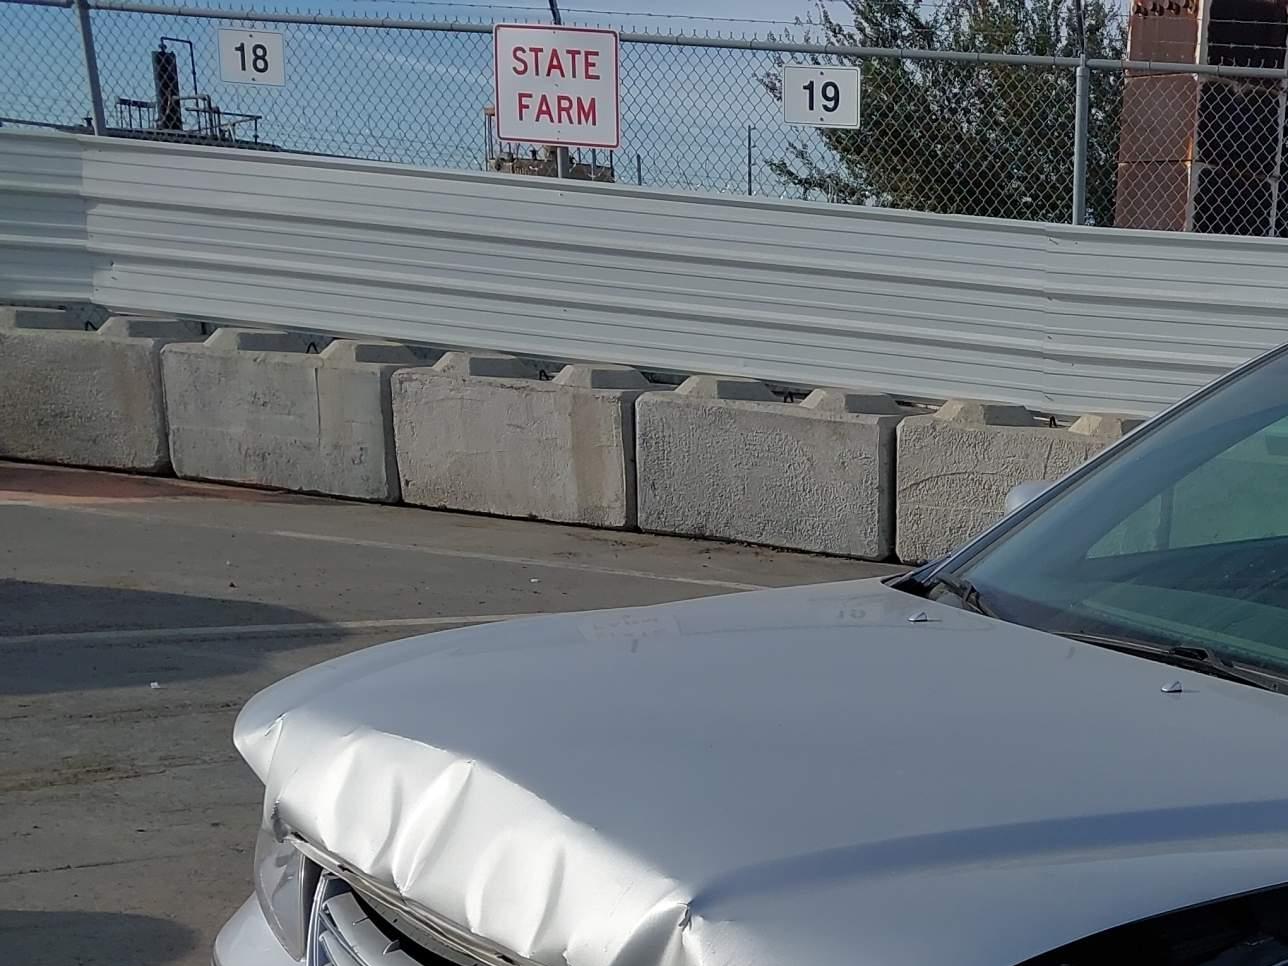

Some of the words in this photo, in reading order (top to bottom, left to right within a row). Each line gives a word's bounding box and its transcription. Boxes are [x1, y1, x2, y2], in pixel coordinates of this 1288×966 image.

[234, 42, 269, 73] 18
[512, 46, 600, 80] STATE
[518, 92, 597, 126] FARM
[803, 80, 840, 112] 19
